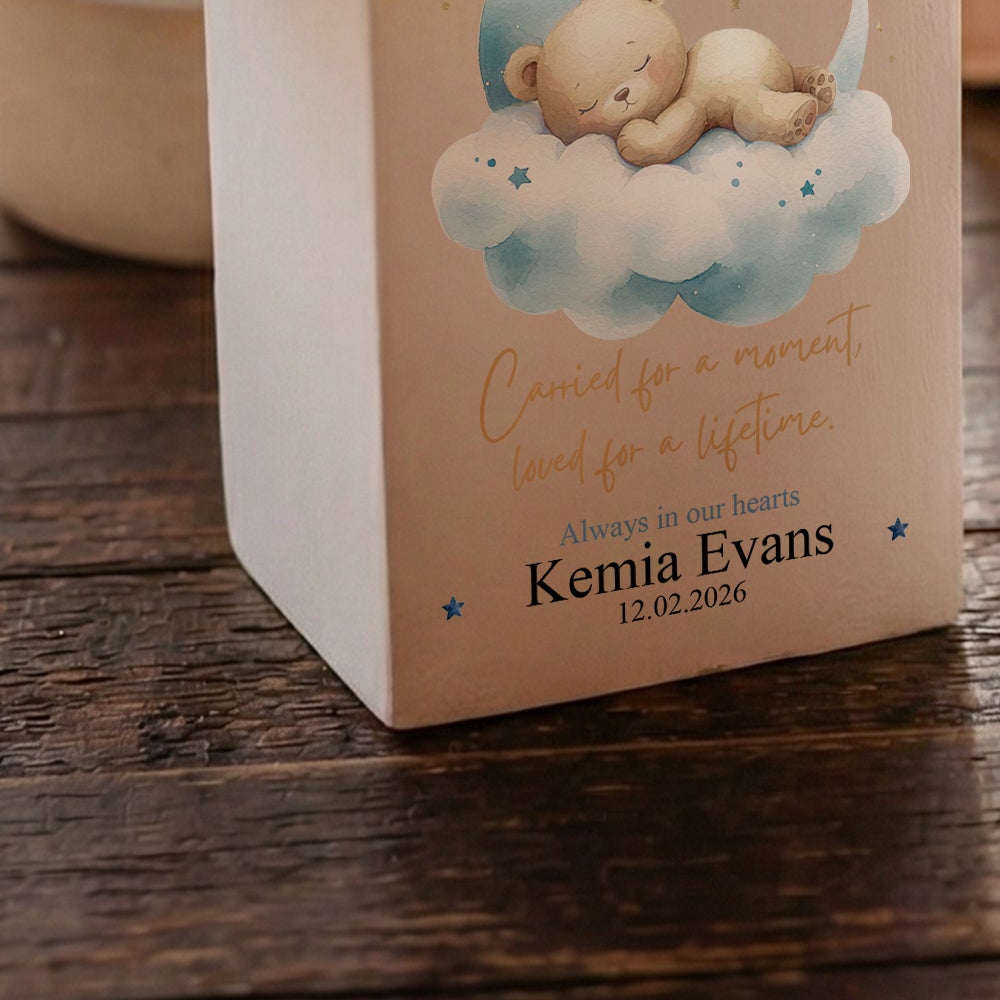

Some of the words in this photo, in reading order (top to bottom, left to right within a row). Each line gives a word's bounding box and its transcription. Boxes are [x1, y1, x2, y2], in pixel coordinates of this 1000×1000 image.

[480, 348, 622, 442] Carried
[632, 358, 680, 412] for
[695, 353, 717, 376] a
[734, 302, 871, 368] moment,
[512, 430, 586, 491] loved
[593, 438, 644, 492] for
[659, 433, 683, 455] a
[699, 393, 834, 472] lifetime.
[560, 514, 648, 546] Always
[657, 506, 679, 529] in
[686, 501, 726, 524] our
[732, 487, 801, 516] hearts
[525, 541, 681, 607] Kemia
[696, 523, 835, 577] Evans
[618, 580, 747, 625] 12.02.2026
